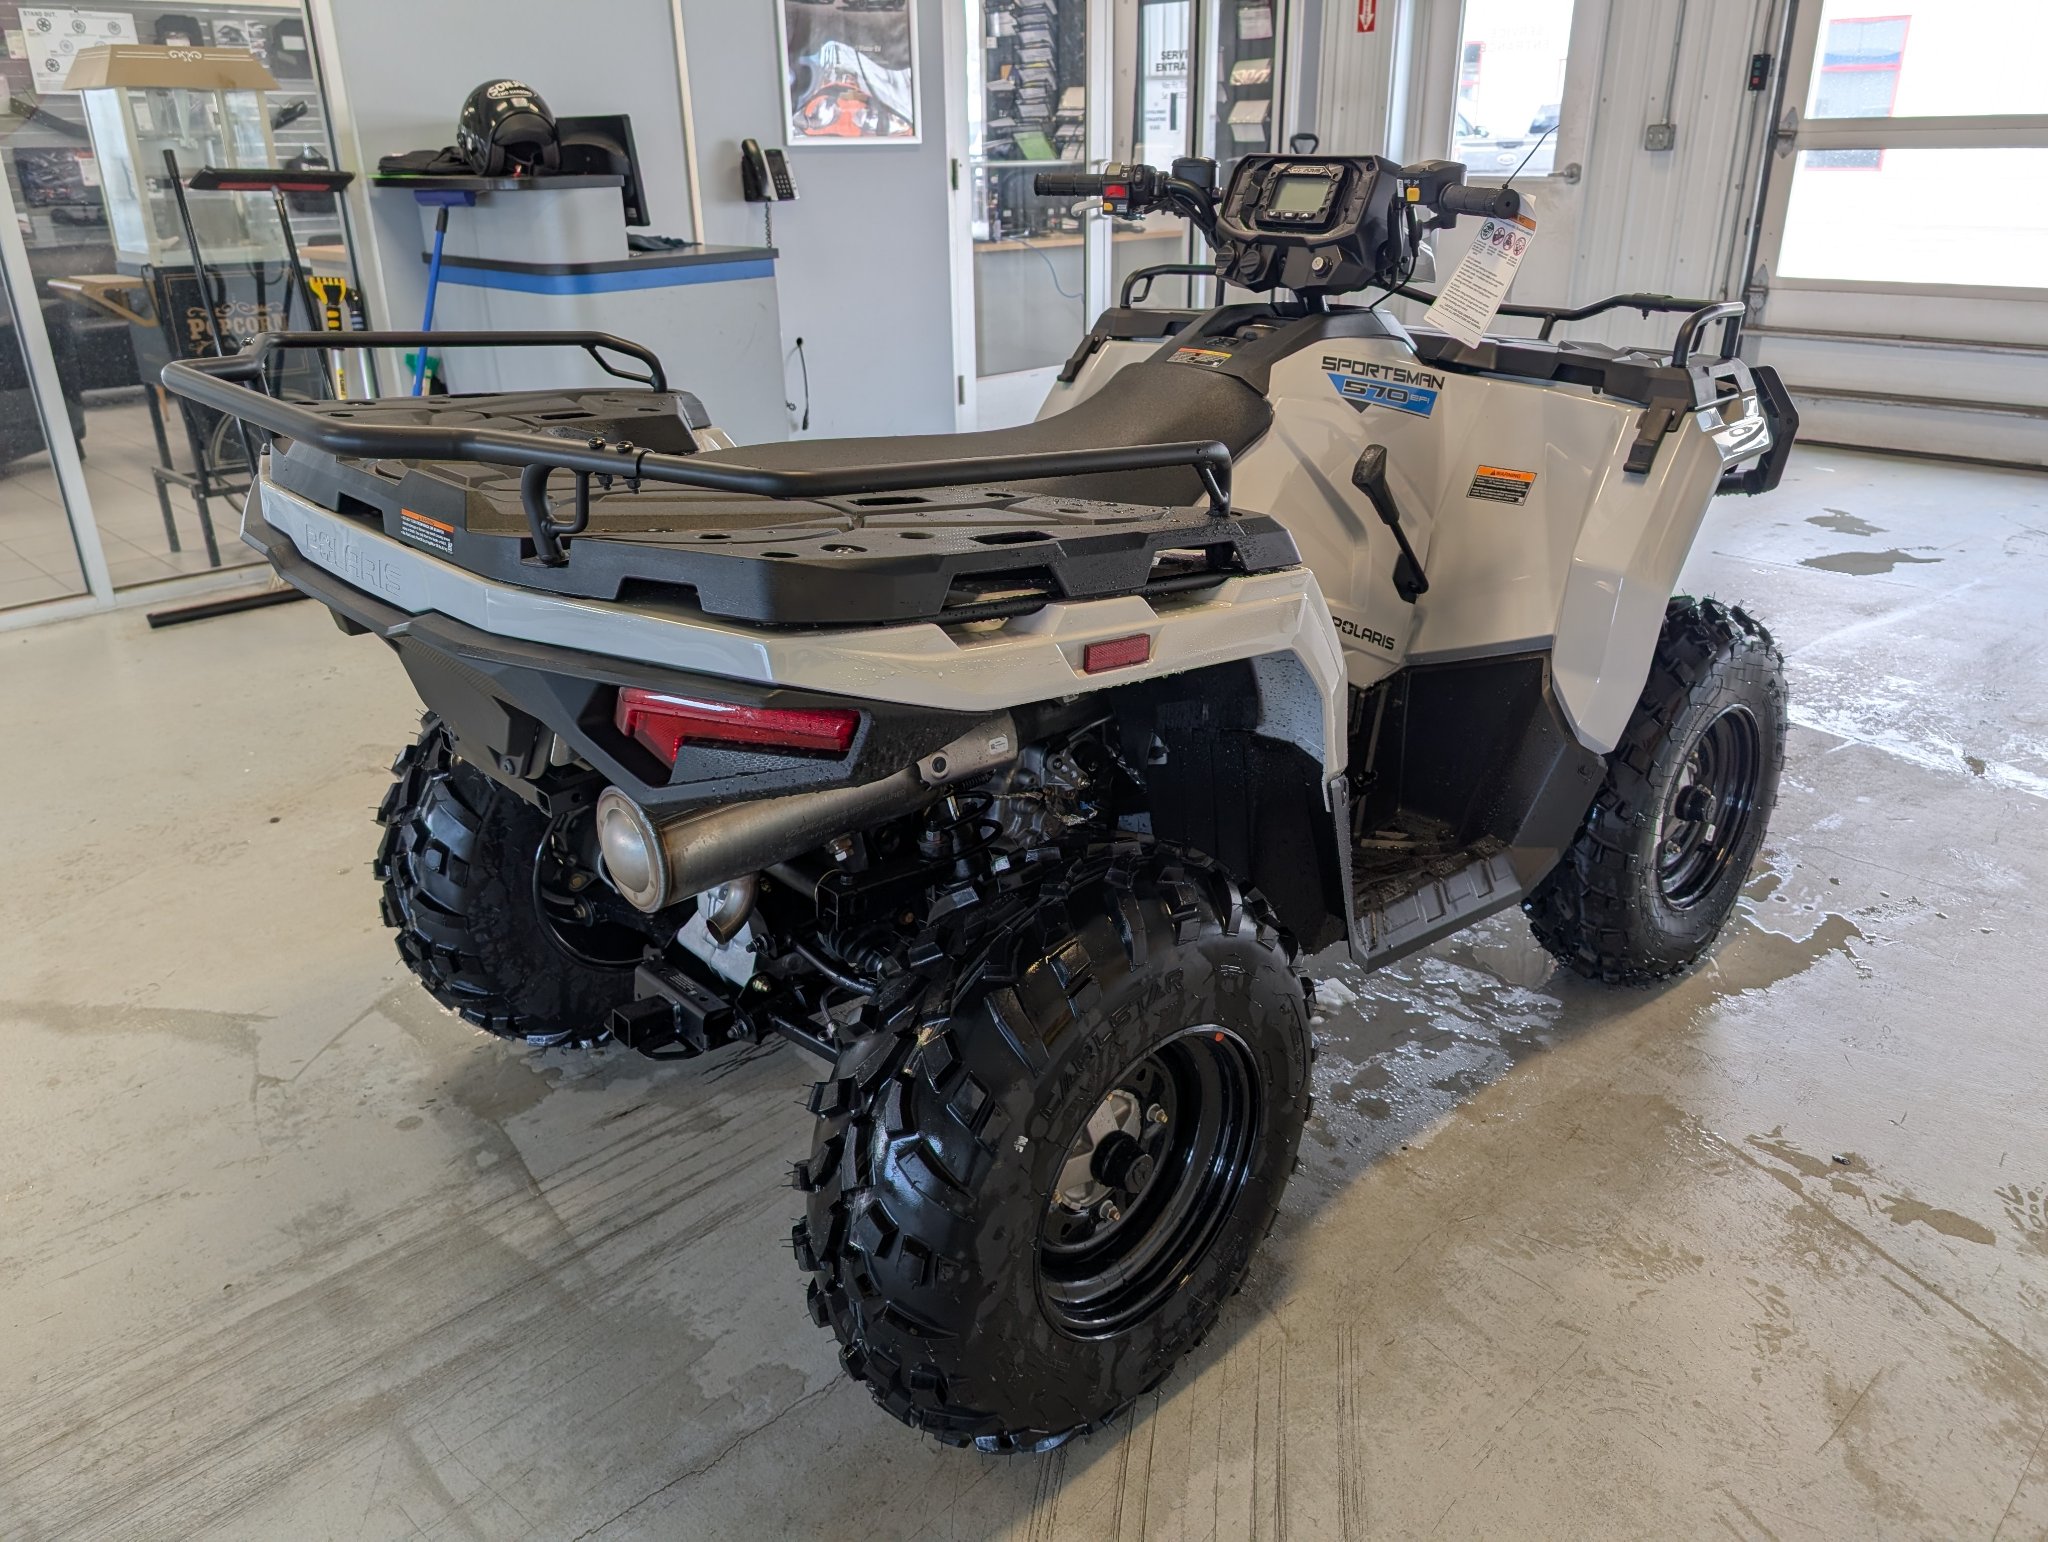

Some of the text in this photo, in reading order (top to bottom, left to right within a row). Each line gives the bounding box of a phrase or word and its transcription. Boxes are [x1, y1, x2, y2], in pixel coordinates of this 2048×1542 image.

[1155, 62, 1187, 72] ENTRA
[1161, 49, 1188, 61] SERVI
[187, 313, 287, 340] POPCORN
[1321, 355, 1446, 390] SPORTSMAN
[1342, 379, 1409, 404] 570
[305, 523, 402, 597] POLARIS
[1332, 616, 1396, 651] POLARIS
